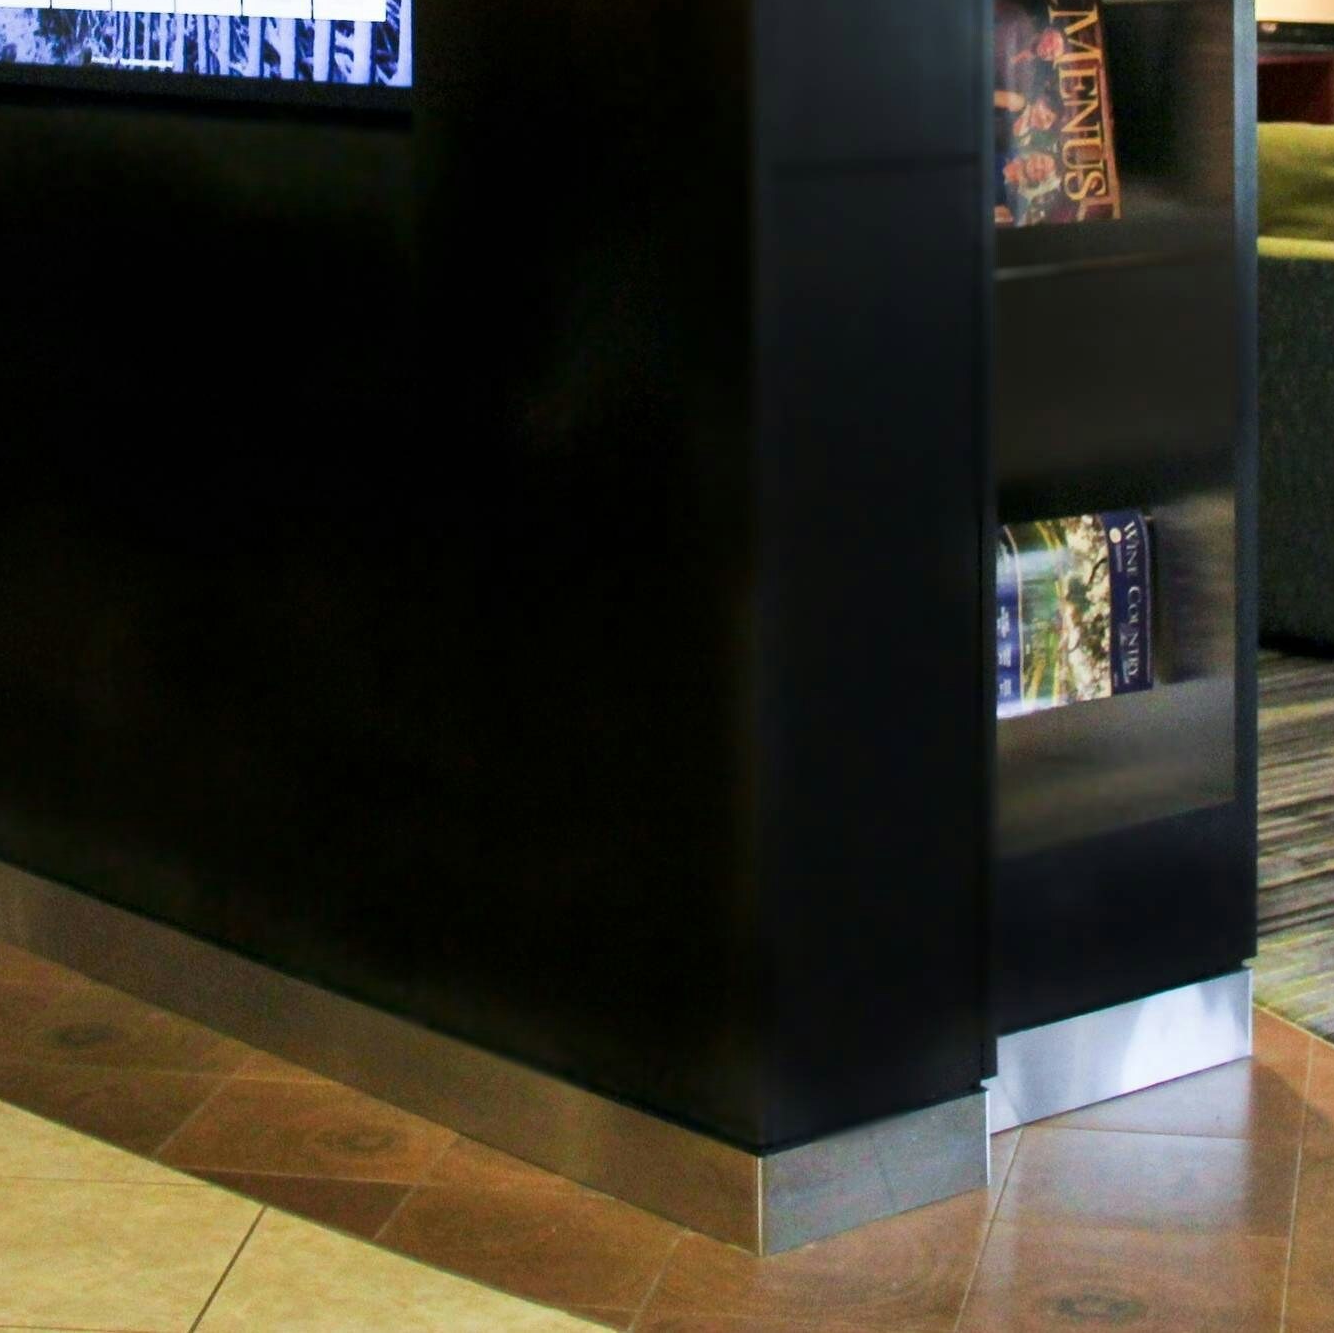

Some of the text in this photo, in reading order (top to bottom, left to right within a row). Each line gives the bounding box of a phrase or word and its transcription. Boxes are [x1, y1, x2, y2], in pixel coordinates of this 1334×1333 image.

[1048, 5, 1107, 201] MENUS
[1123, 521, 1142, 677] WINE COUNTRY
